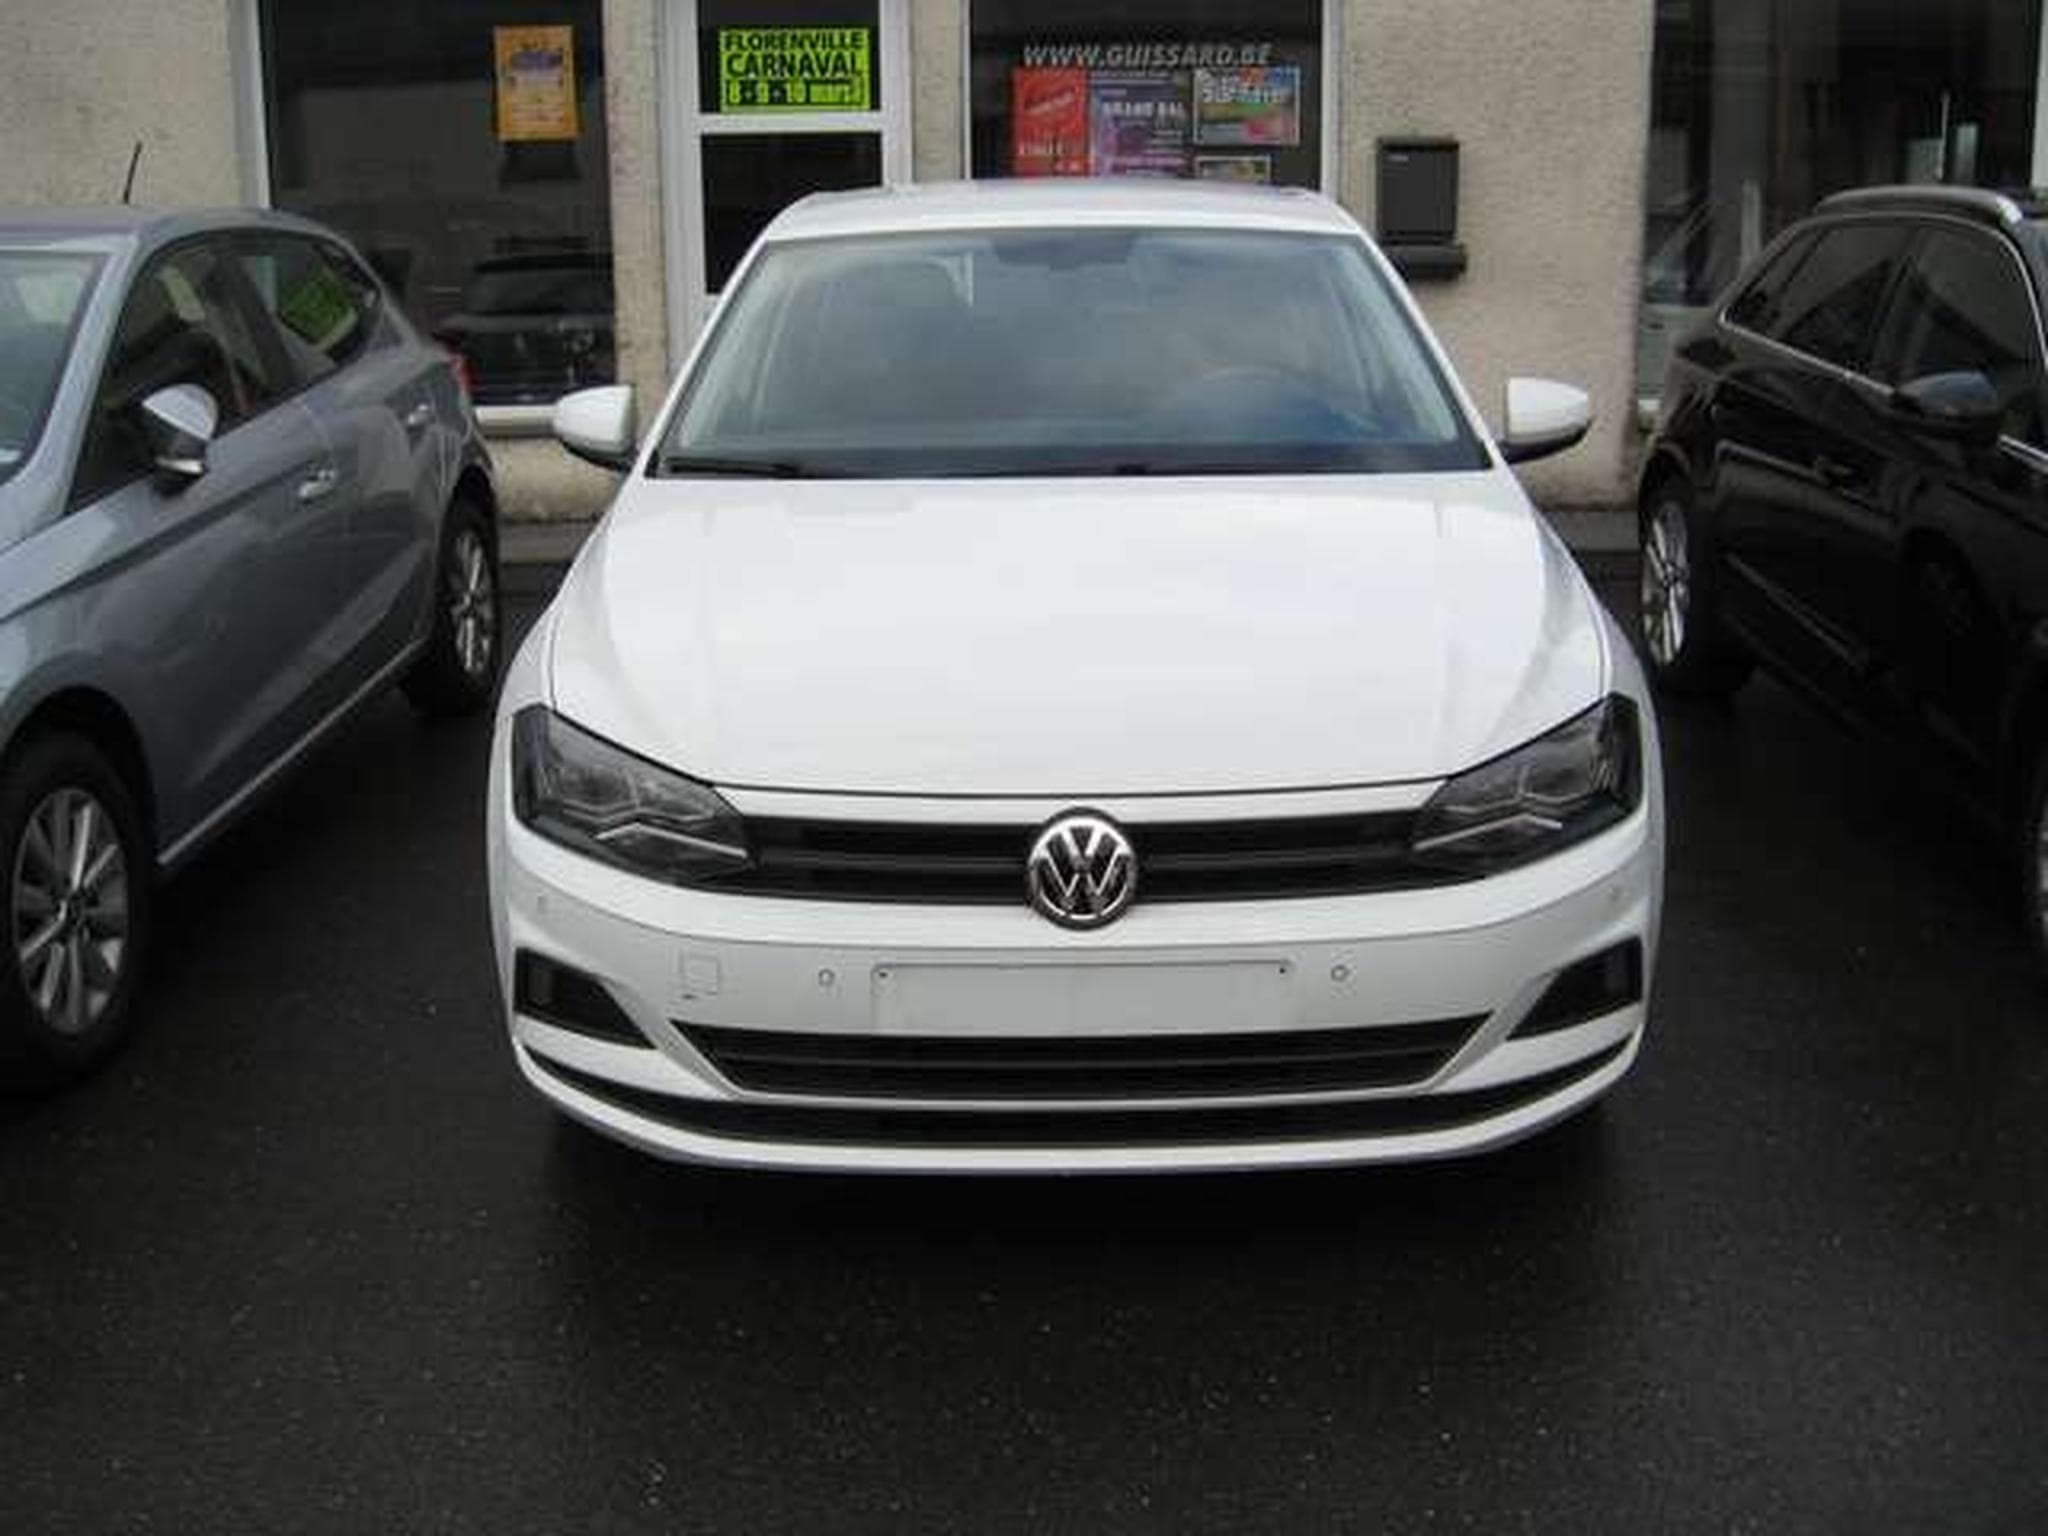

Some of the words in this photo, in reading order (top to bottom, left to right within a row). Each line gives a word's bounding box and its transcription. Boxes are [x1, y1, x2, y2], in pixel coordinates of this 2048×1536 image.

[724, 31, 865, 50] FLORENVILLE
[726, 52, 864, 77] CARNAVAL
[1029, 814, 1136, 922] VW
